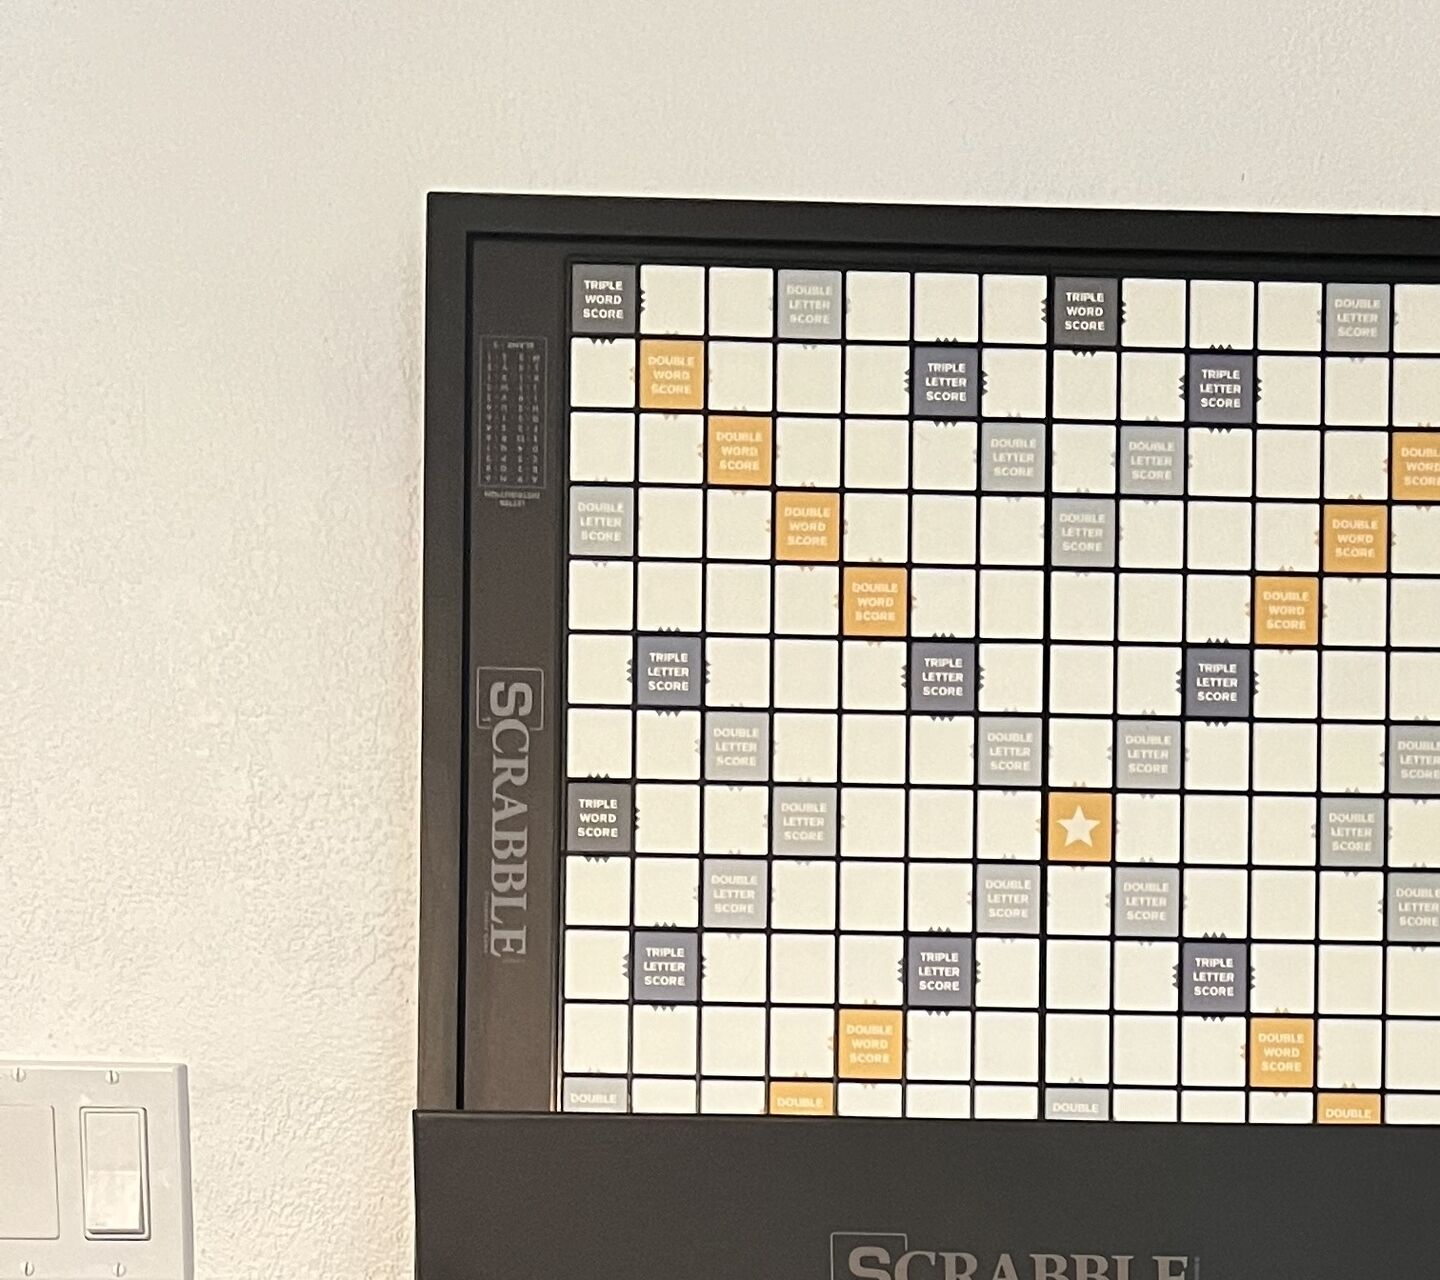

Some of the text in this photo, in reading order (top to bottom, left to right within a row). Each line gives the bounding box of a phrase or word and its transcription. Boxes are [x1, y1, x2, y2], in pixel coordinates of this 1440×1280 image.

[584, 280, 623, 291] TRIPLE
[584, 294, 622, 305] WORD
[583, 308, 623, 319] SCORE
[647, 355, 695, 366] DOUBLE
[653, 370, 690, 380] WORD
[651, 383, 690, 395] SCORE
[1199, 663, 1237, 673] TRIPLE
[1196, 677, 1238, 688] LETTER
[1197, 691, 1237, 702] SCORE
[489, 681, 533, 957] SCRABBLE
